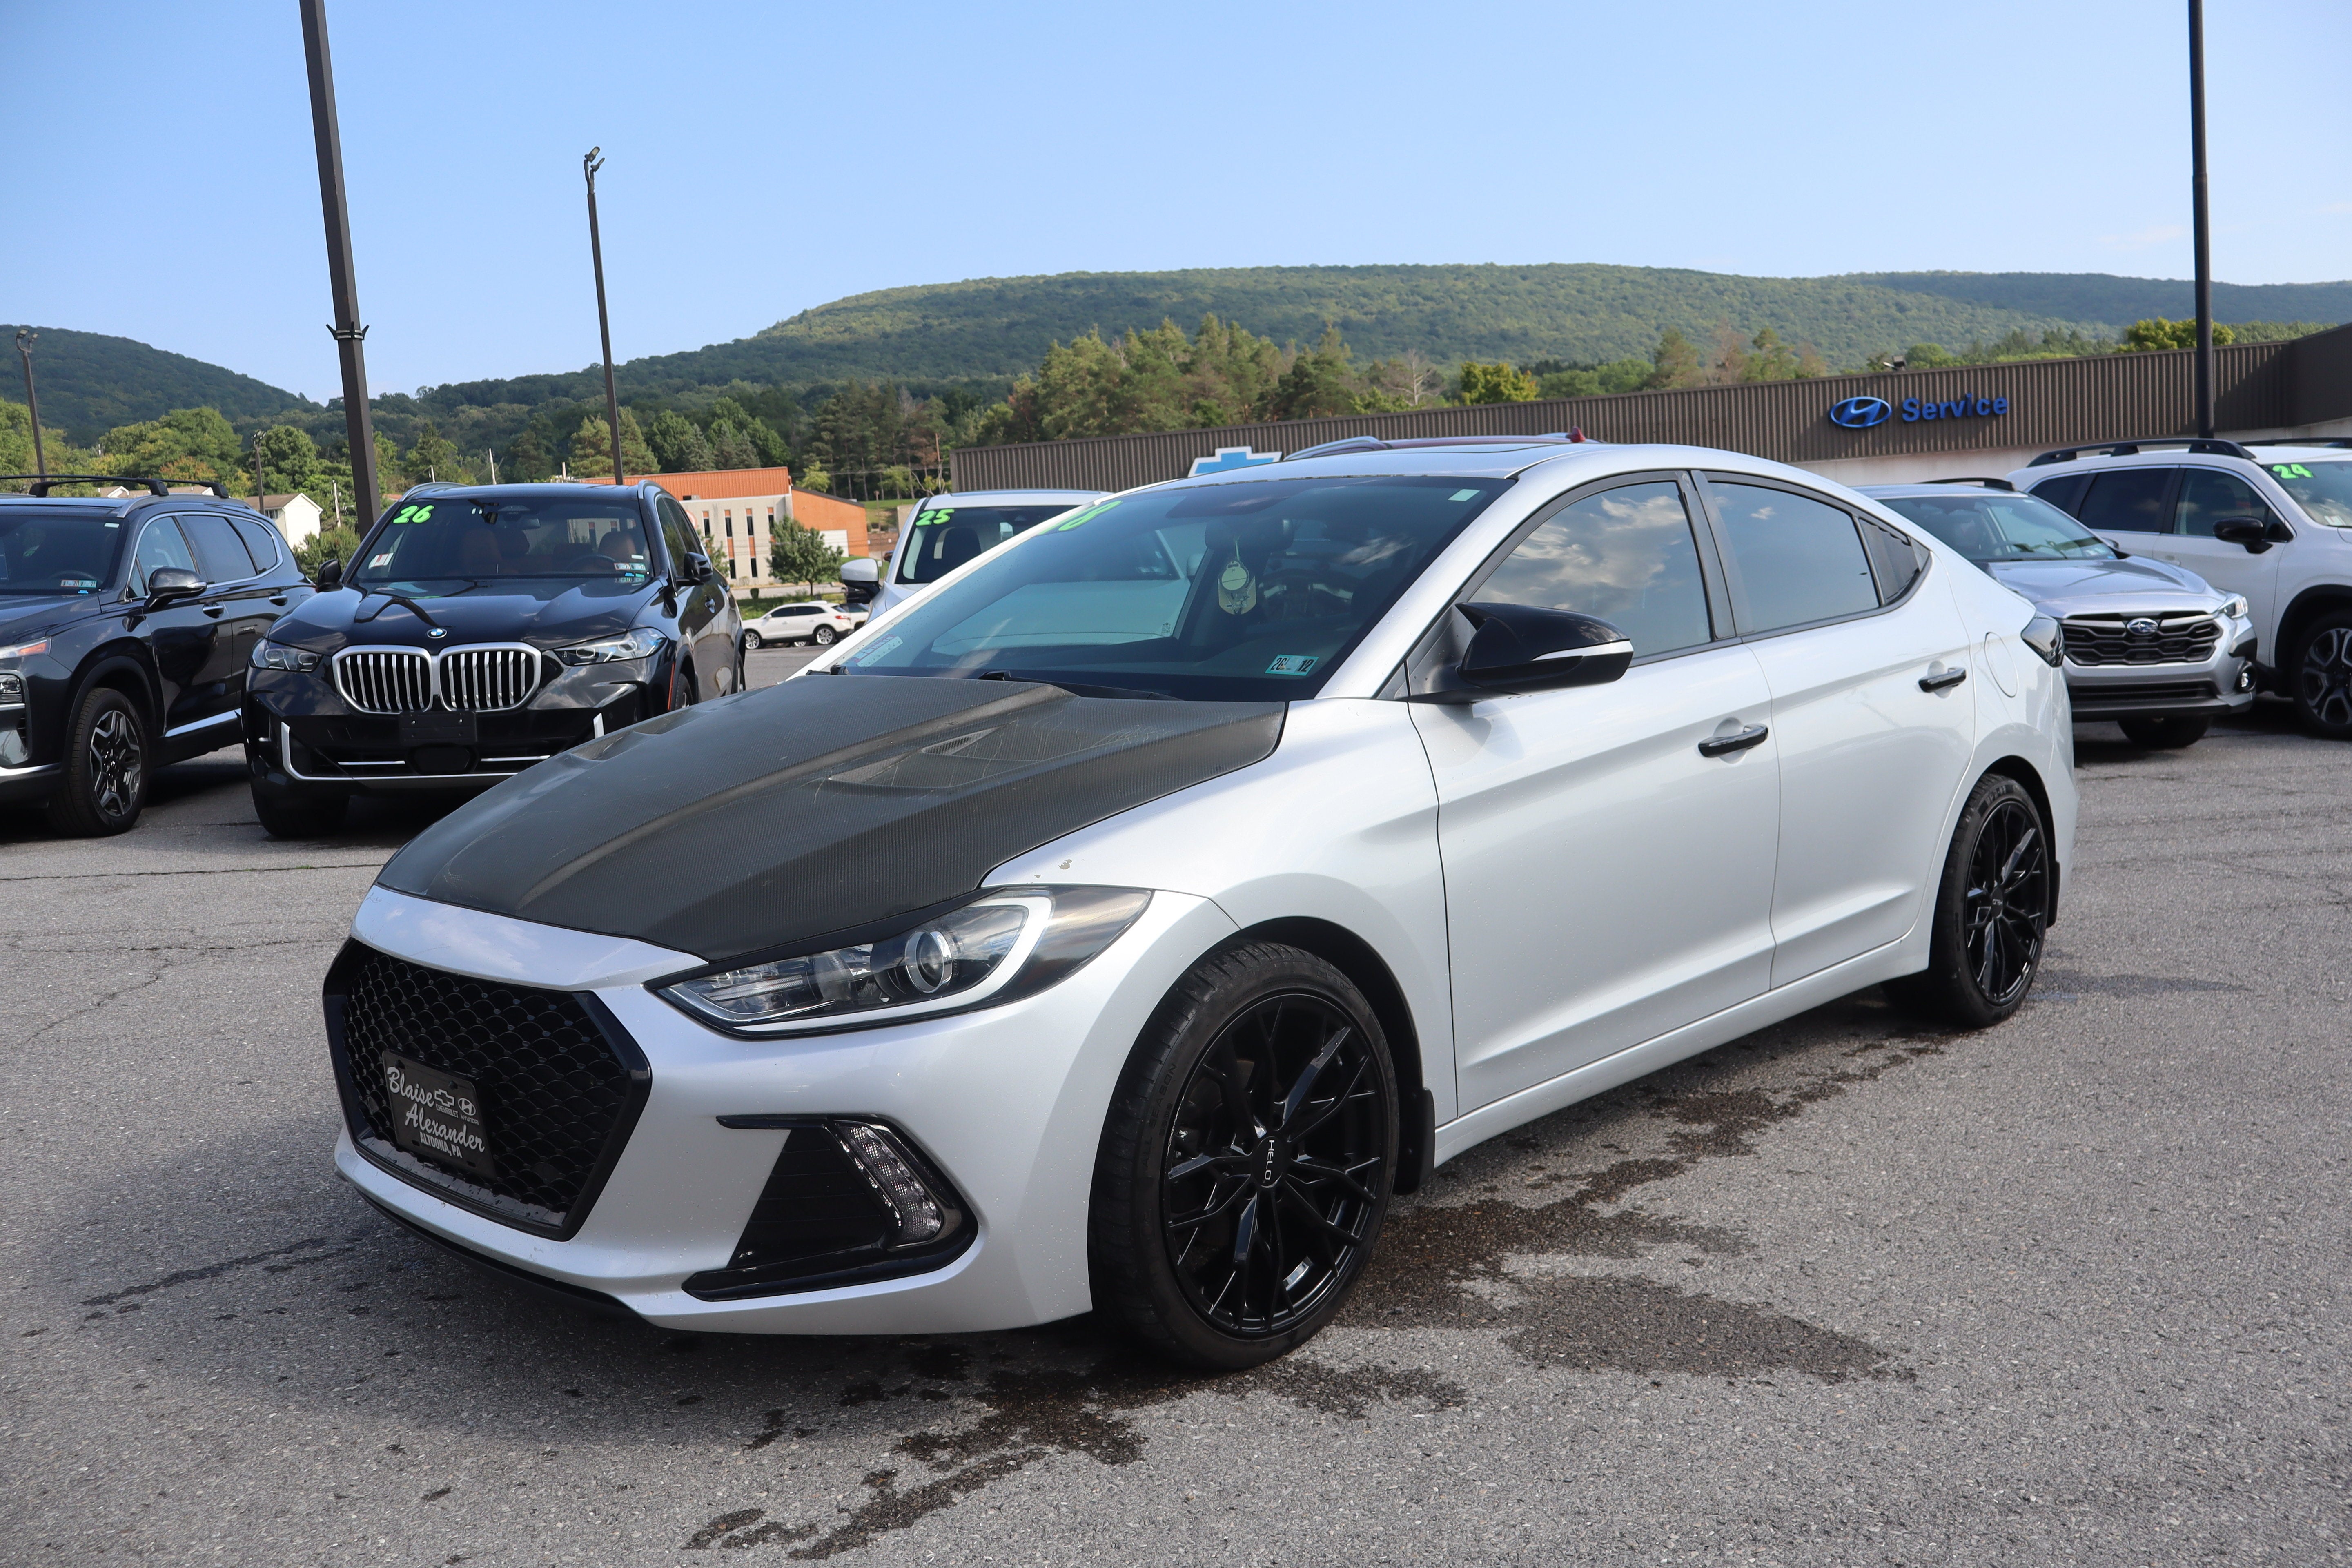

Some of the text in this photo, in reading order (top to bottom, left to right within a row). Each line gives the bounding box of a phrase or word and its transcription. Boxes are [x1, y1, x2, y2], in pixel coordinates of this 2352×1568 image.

[1902, 393, 2008, 422] Service
[2272, 463, 2314, 479] 24
[393, 505, 435, 523] 26
[915, 509, 955, 526] 25
[1298, 659, 1314, 672] 12
[387, 1067, 434, 1107] Blaise
[1148, 1062, 1177, 1129] SEASON
[436, 1103, 459, 1118] CHEVROLET
[405, 1103, 485, 1152] Alexander
[420, 1131, 463, 1158] ALTOONA, PA
[1265, 1140, 1275, 1180] HELO
